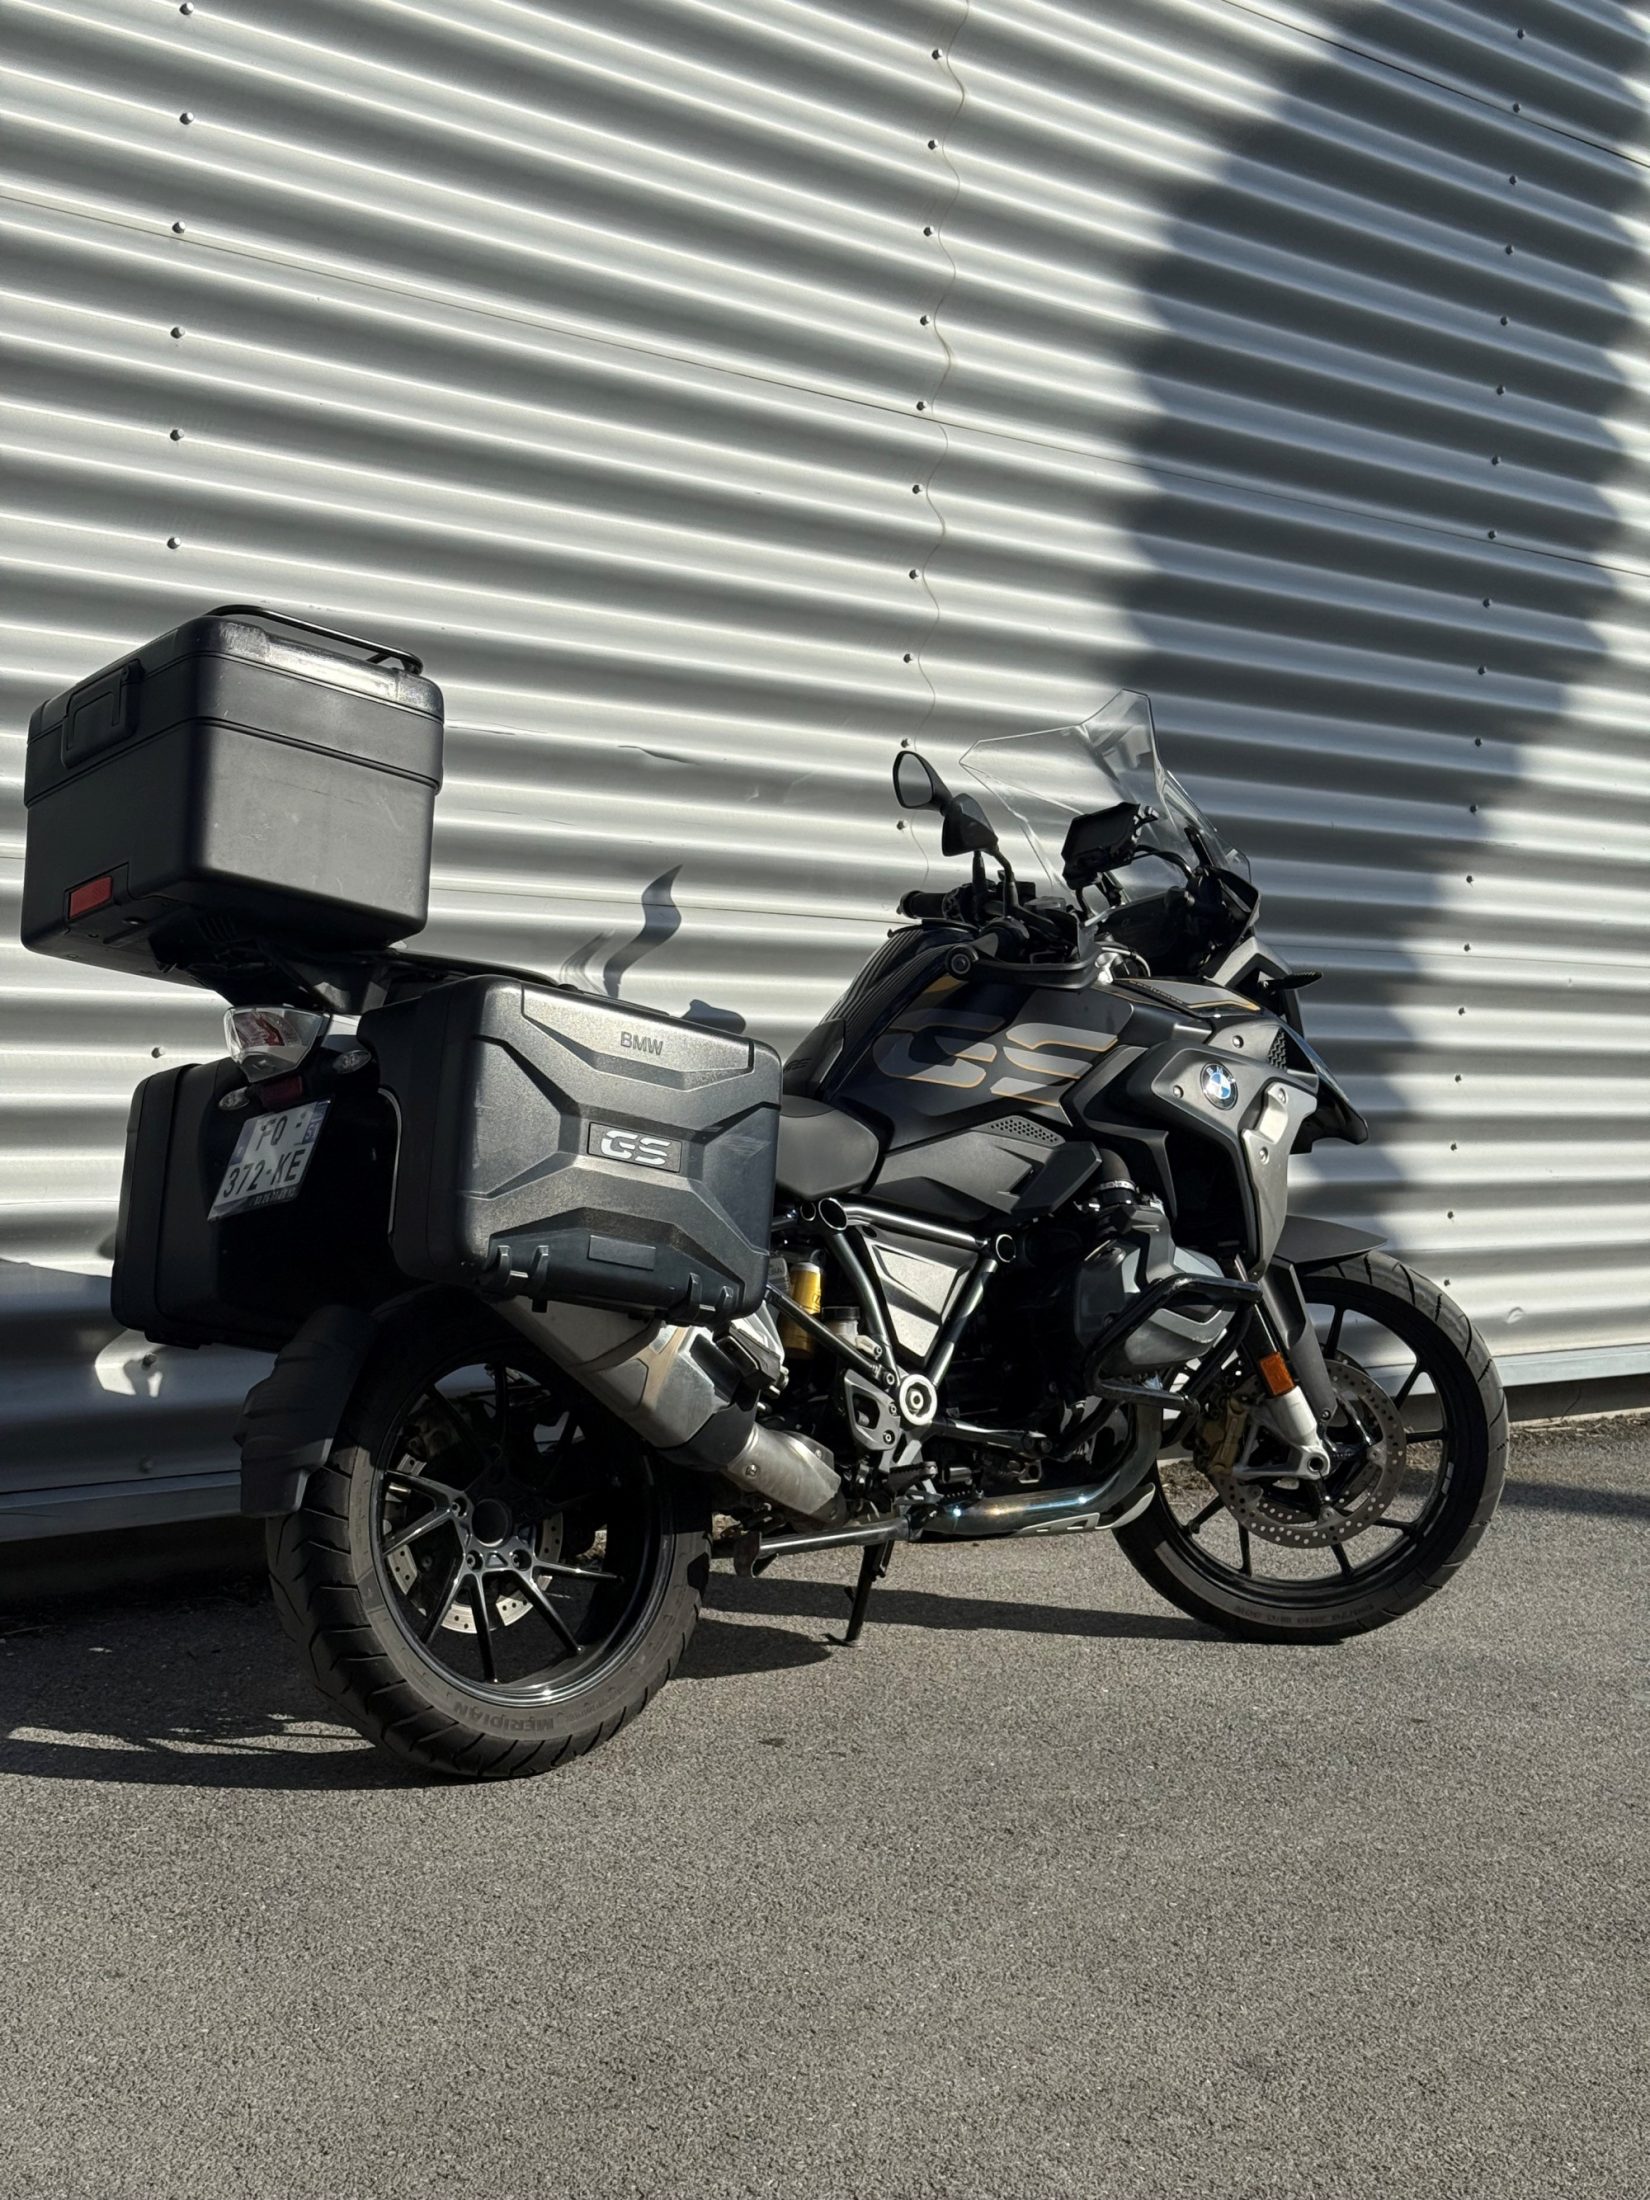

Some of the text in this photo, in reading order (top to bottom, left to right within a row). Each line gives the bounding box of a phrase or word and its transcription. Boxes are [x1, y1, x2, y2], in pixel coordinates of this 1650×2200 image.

[620, 1031, 664, 1056] BMW
[872, 1008, 1119, 1109] GS
[600, 1130, 671, 1166] GS
[223, 1149, 306, 1198] 372-KE
[453, 1702, 555, 1731] MERIDIAN
